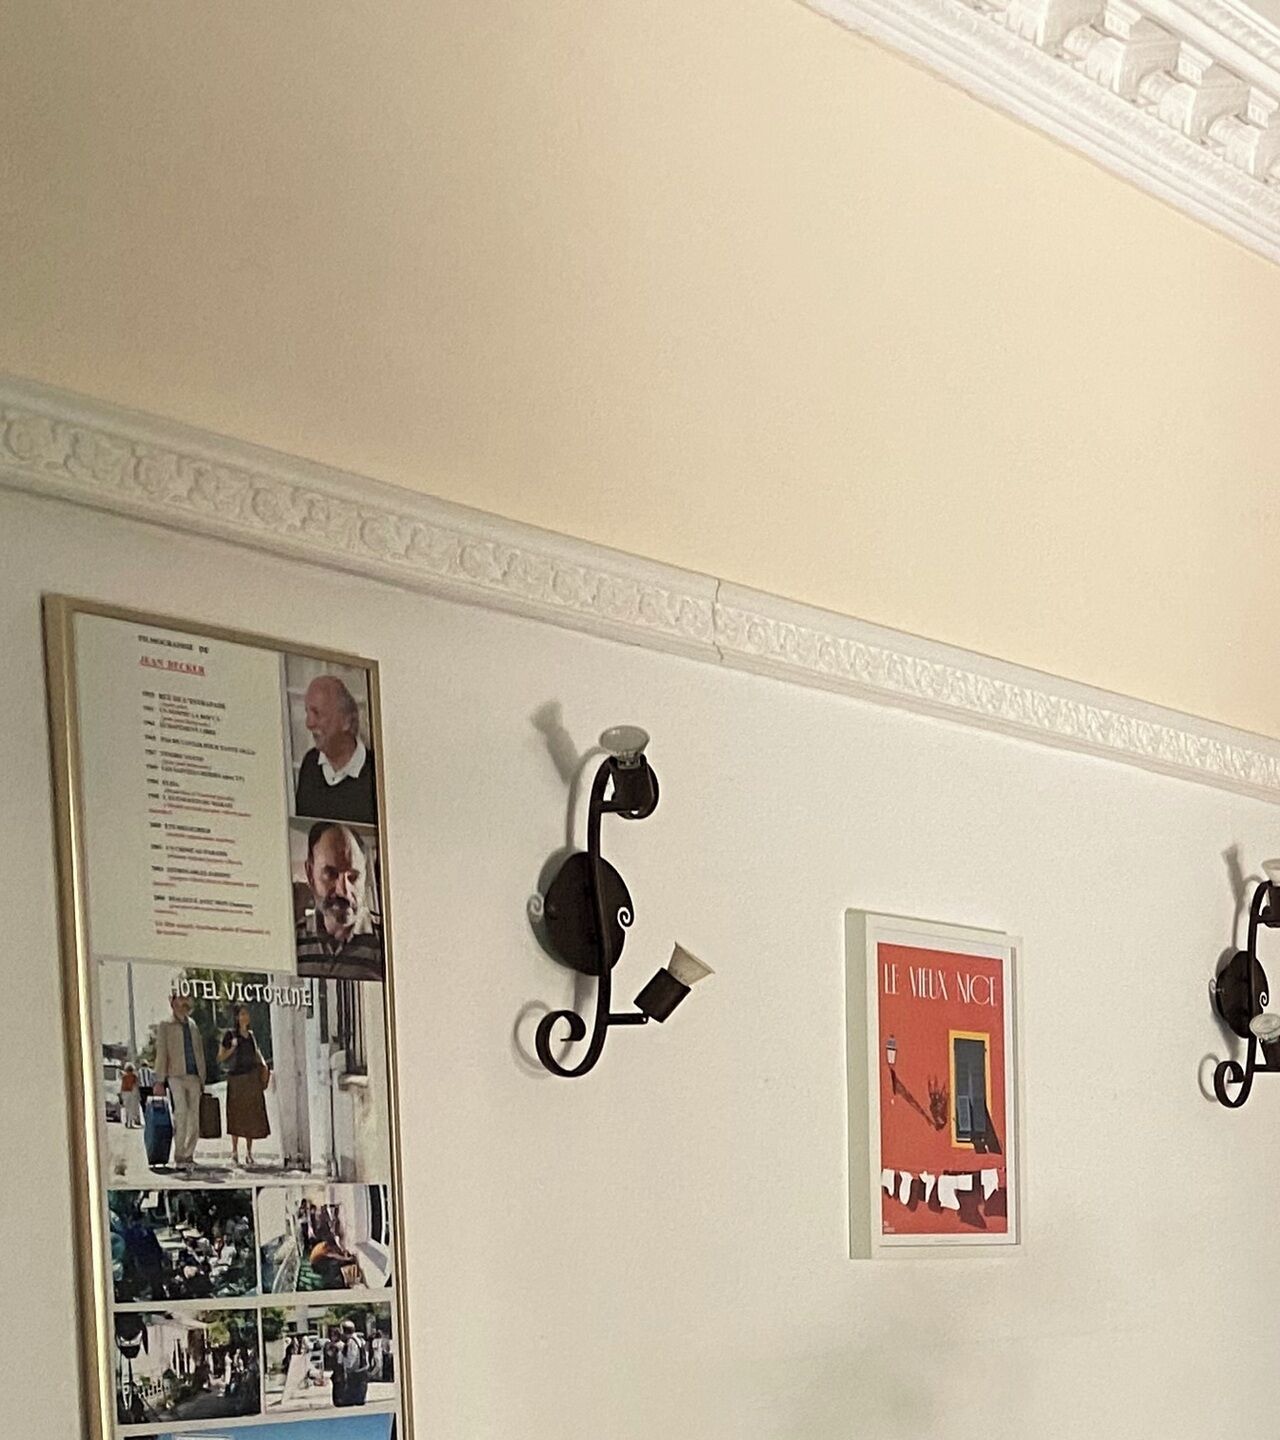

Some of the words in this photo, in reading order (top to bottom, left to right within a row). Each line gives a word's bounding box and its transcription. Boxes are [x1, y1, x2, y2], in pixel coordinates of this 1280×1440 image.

[170, 979, 220, 1000] HOTEL
[224, 981, 313, 1010] VICTORINE
[884, 963, 900, 995] LE
[909, 965, 948, 1001] VIEUX
[956, 972, 998, 1007] NICE
